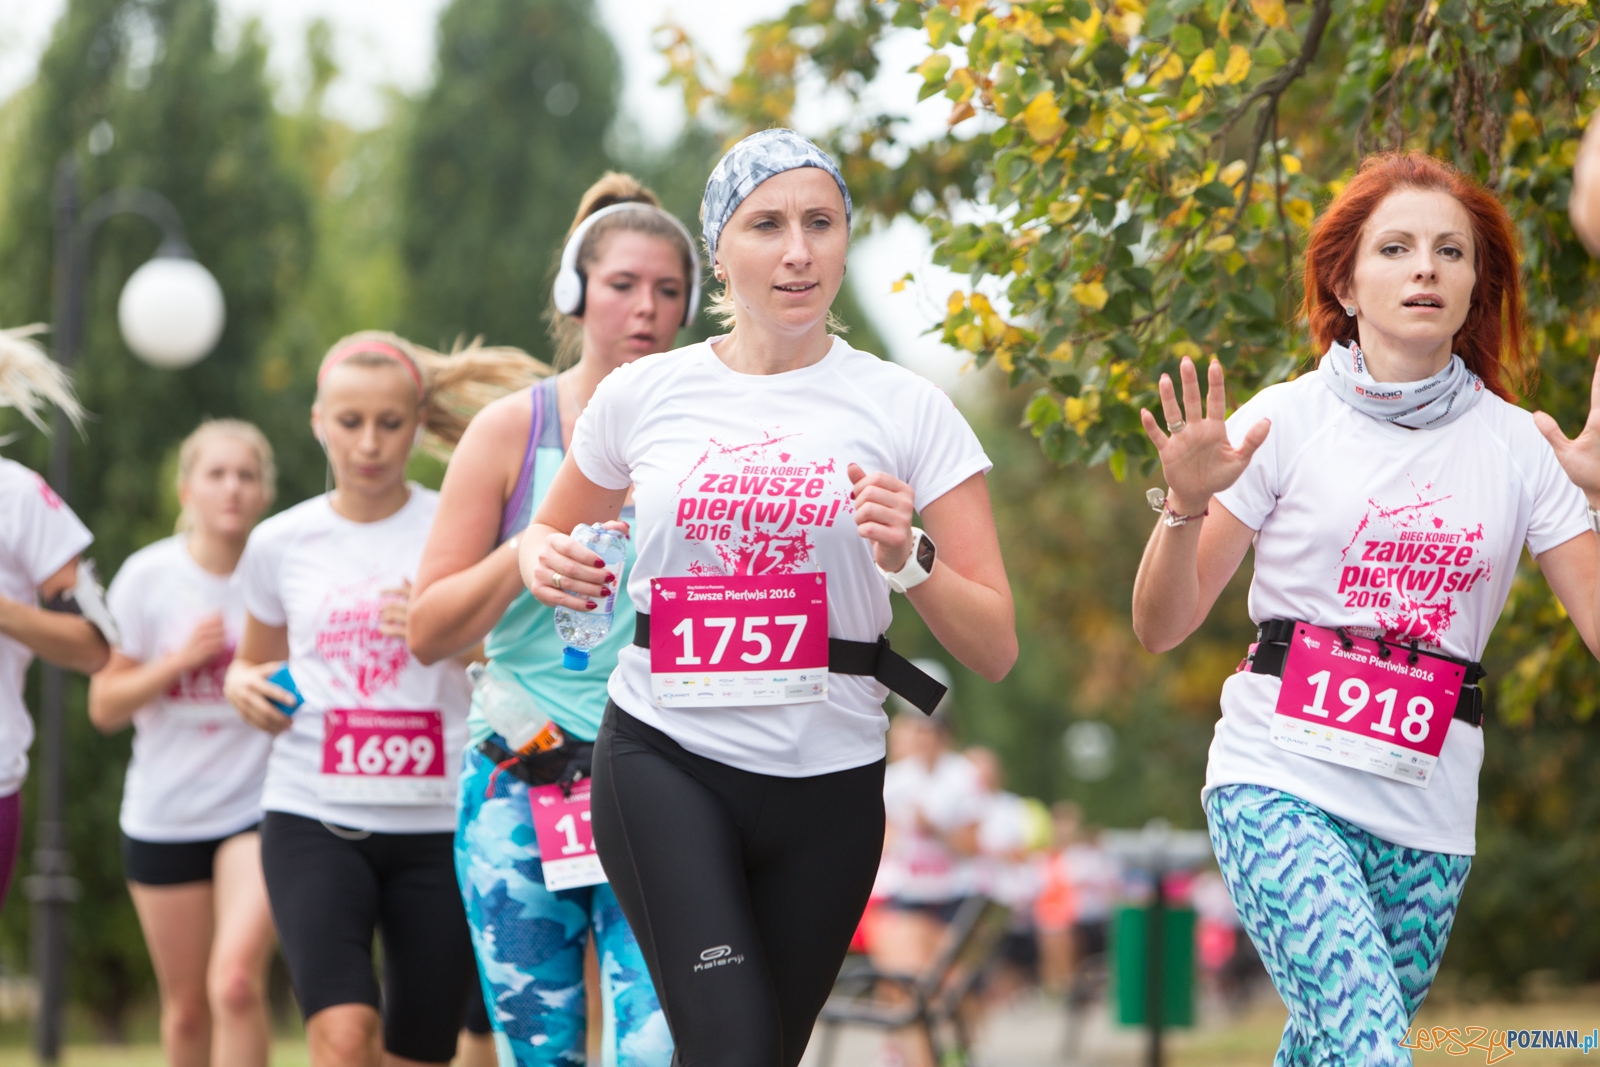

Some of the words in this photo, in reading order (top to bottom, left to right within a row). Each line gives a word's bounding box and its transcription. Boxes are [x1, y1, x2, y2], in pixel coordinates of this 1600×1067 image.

[1365, 390, 1403, 398] RADIO
[742, 465, 769, 476] BIEG
[770, 466, 811, 477] KOBIET
[698, 473, 825, 498] zawsze
[676, 496, 841, 533] pier(w)si!
[685, 523, 732, 541] 2016
[1399, 531, 1423, 542] BIEG
[1424, 532, 1462, 544] KOBIET
[1361, 541, 1474, 567] zawsze
[687, 590, 723, 601] Zawsze
[725, 589, 767, 602] Pier(w)si
[769, 588, 796, 599] 2016
[1337, 565, 1484, 601] pier(w)si!
[1344, 591, 1392, 608] 2016
[672, 615, 808, 665] 1757
[1330, 645, 1367, 663] Zawsze
[1369, 654, 1408, 675] Pier(w)si
[1409, 667, 1434, 682] 2016
[1302, 669, 1434, 743] 1918
[334, 734, 436, 775] 1699
